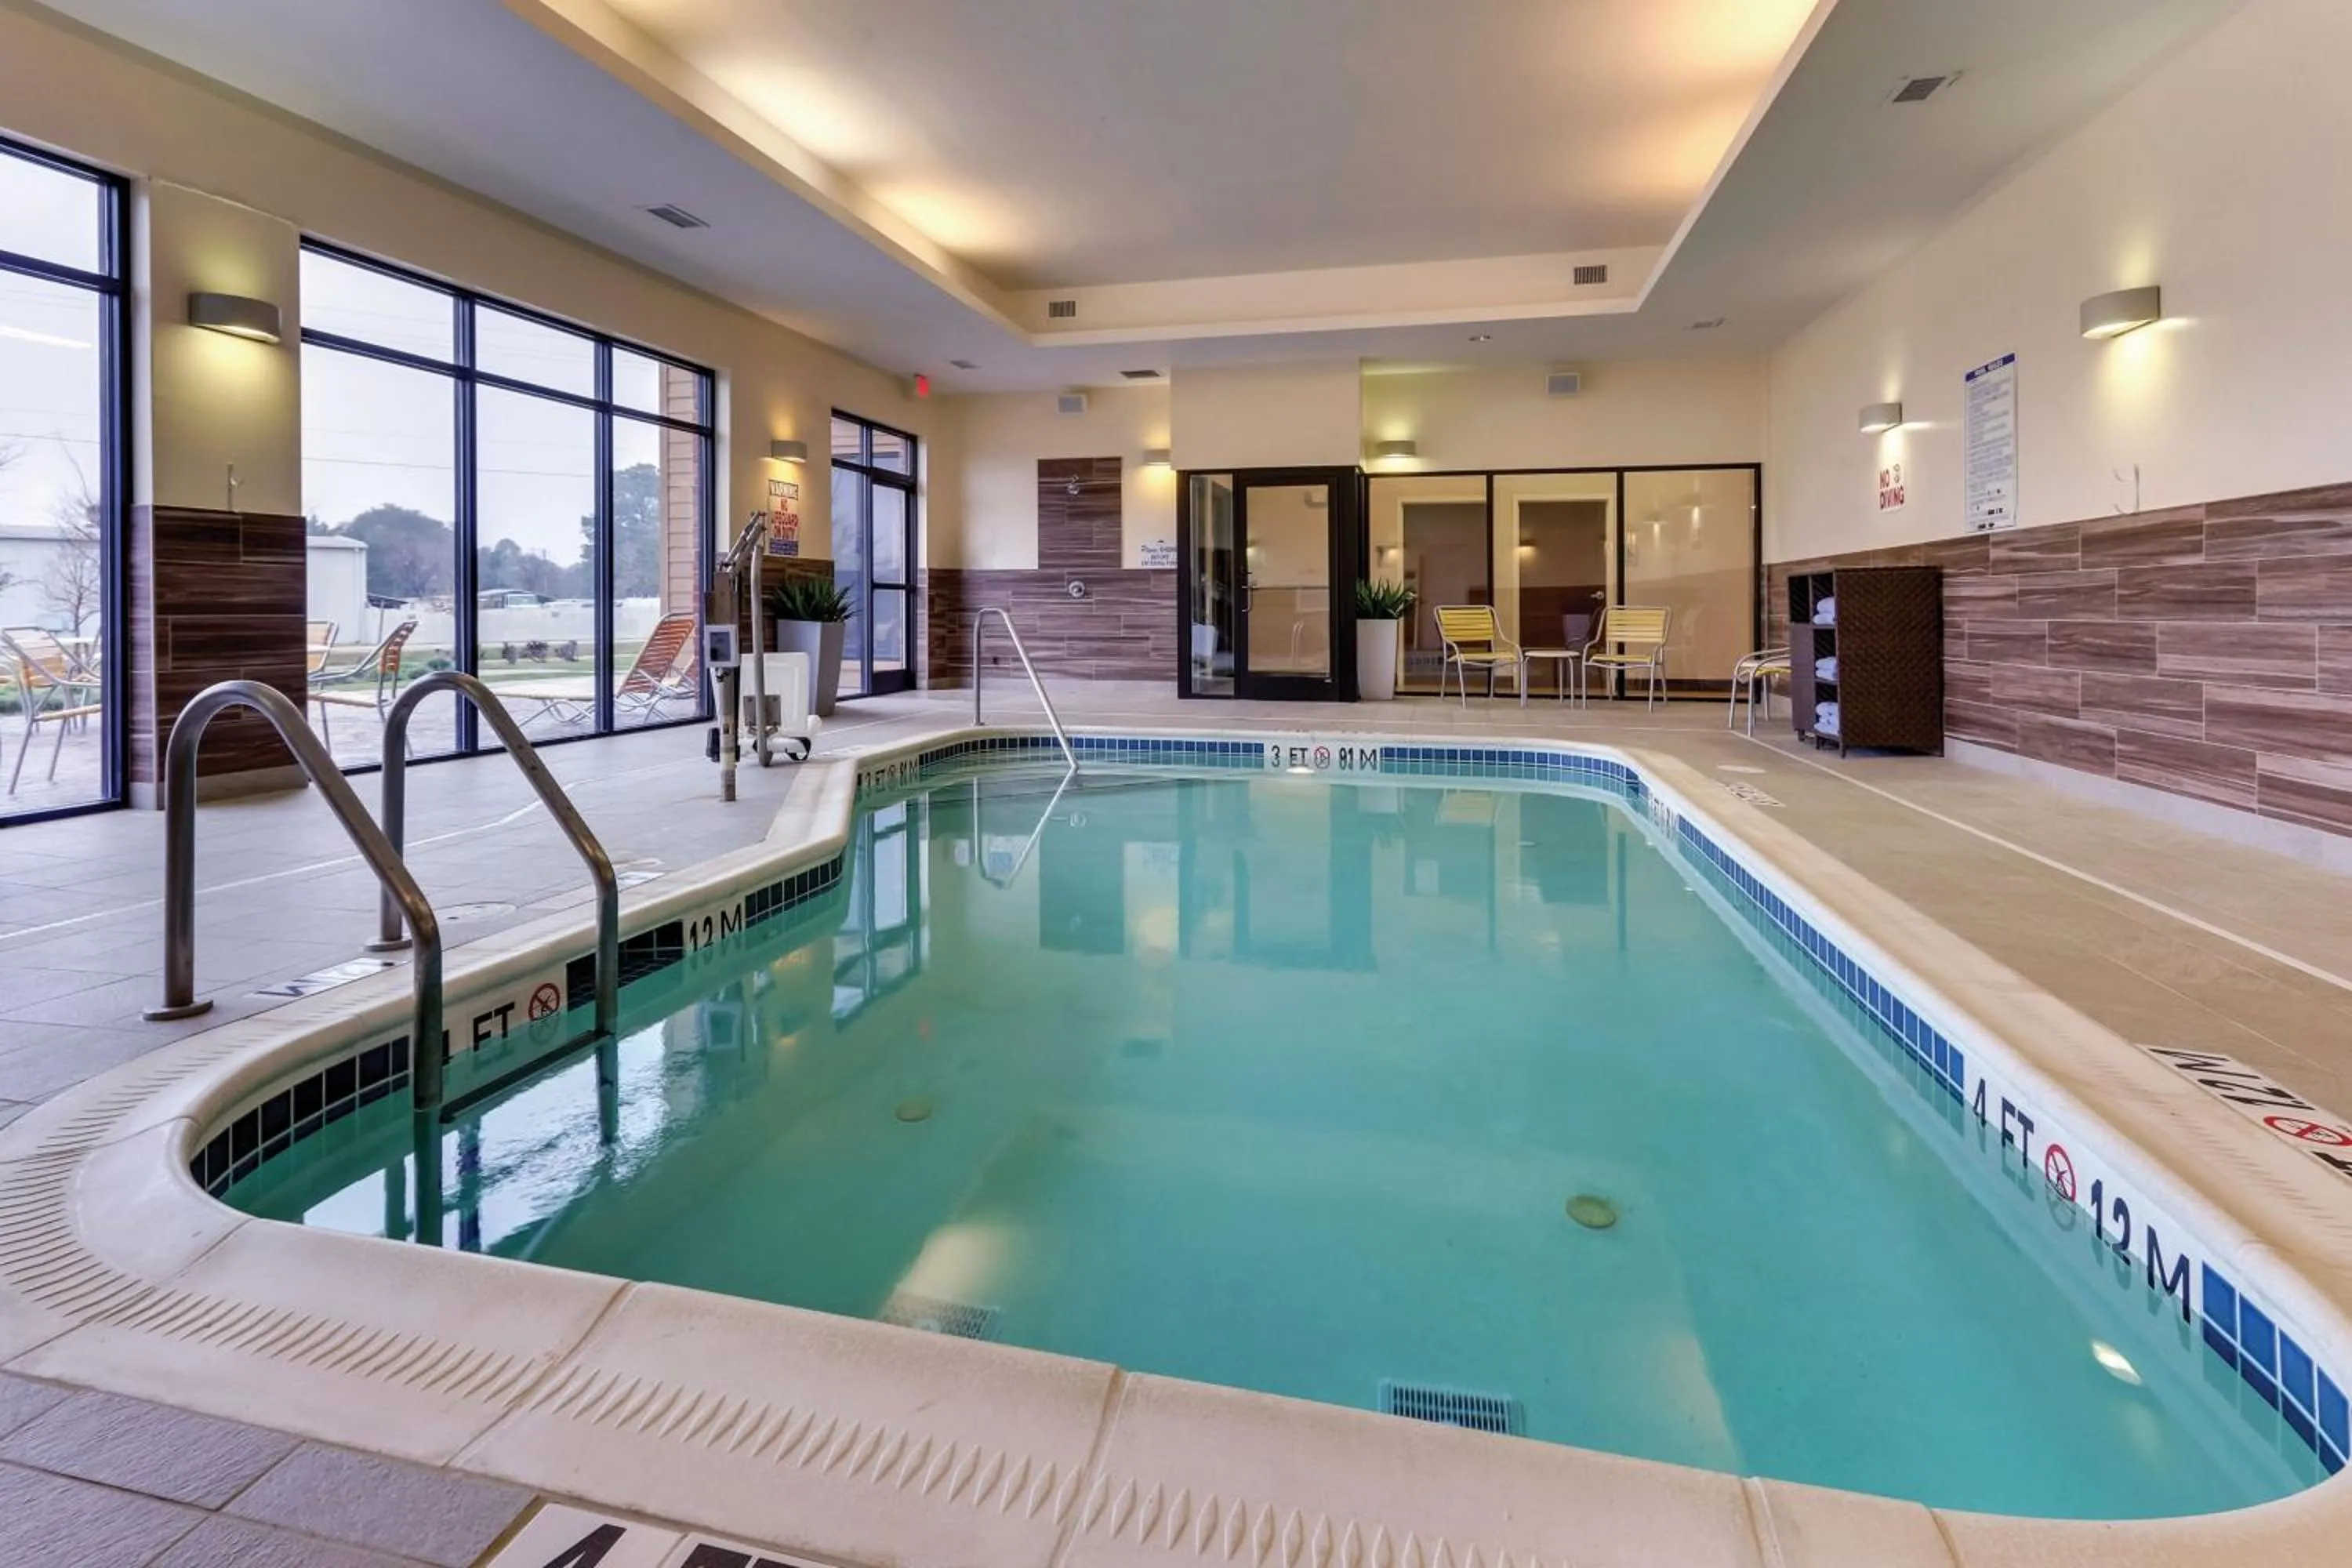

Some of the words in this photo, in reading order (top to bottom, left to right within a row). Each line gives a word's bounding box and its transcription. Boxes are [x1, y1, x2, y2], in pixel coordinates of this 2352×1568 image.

[1879, 469, 1890, 490] NO
[1879, 485, 1904, 510] DIVING
[720, 903, 742, 939] M
[473, 1001, 515, 1053] FT
[1973, 1077, 1987, 1128] 4
[2002, 1096, 2034, 1169] FT
[2147, 1224, 2190, 1325] M
